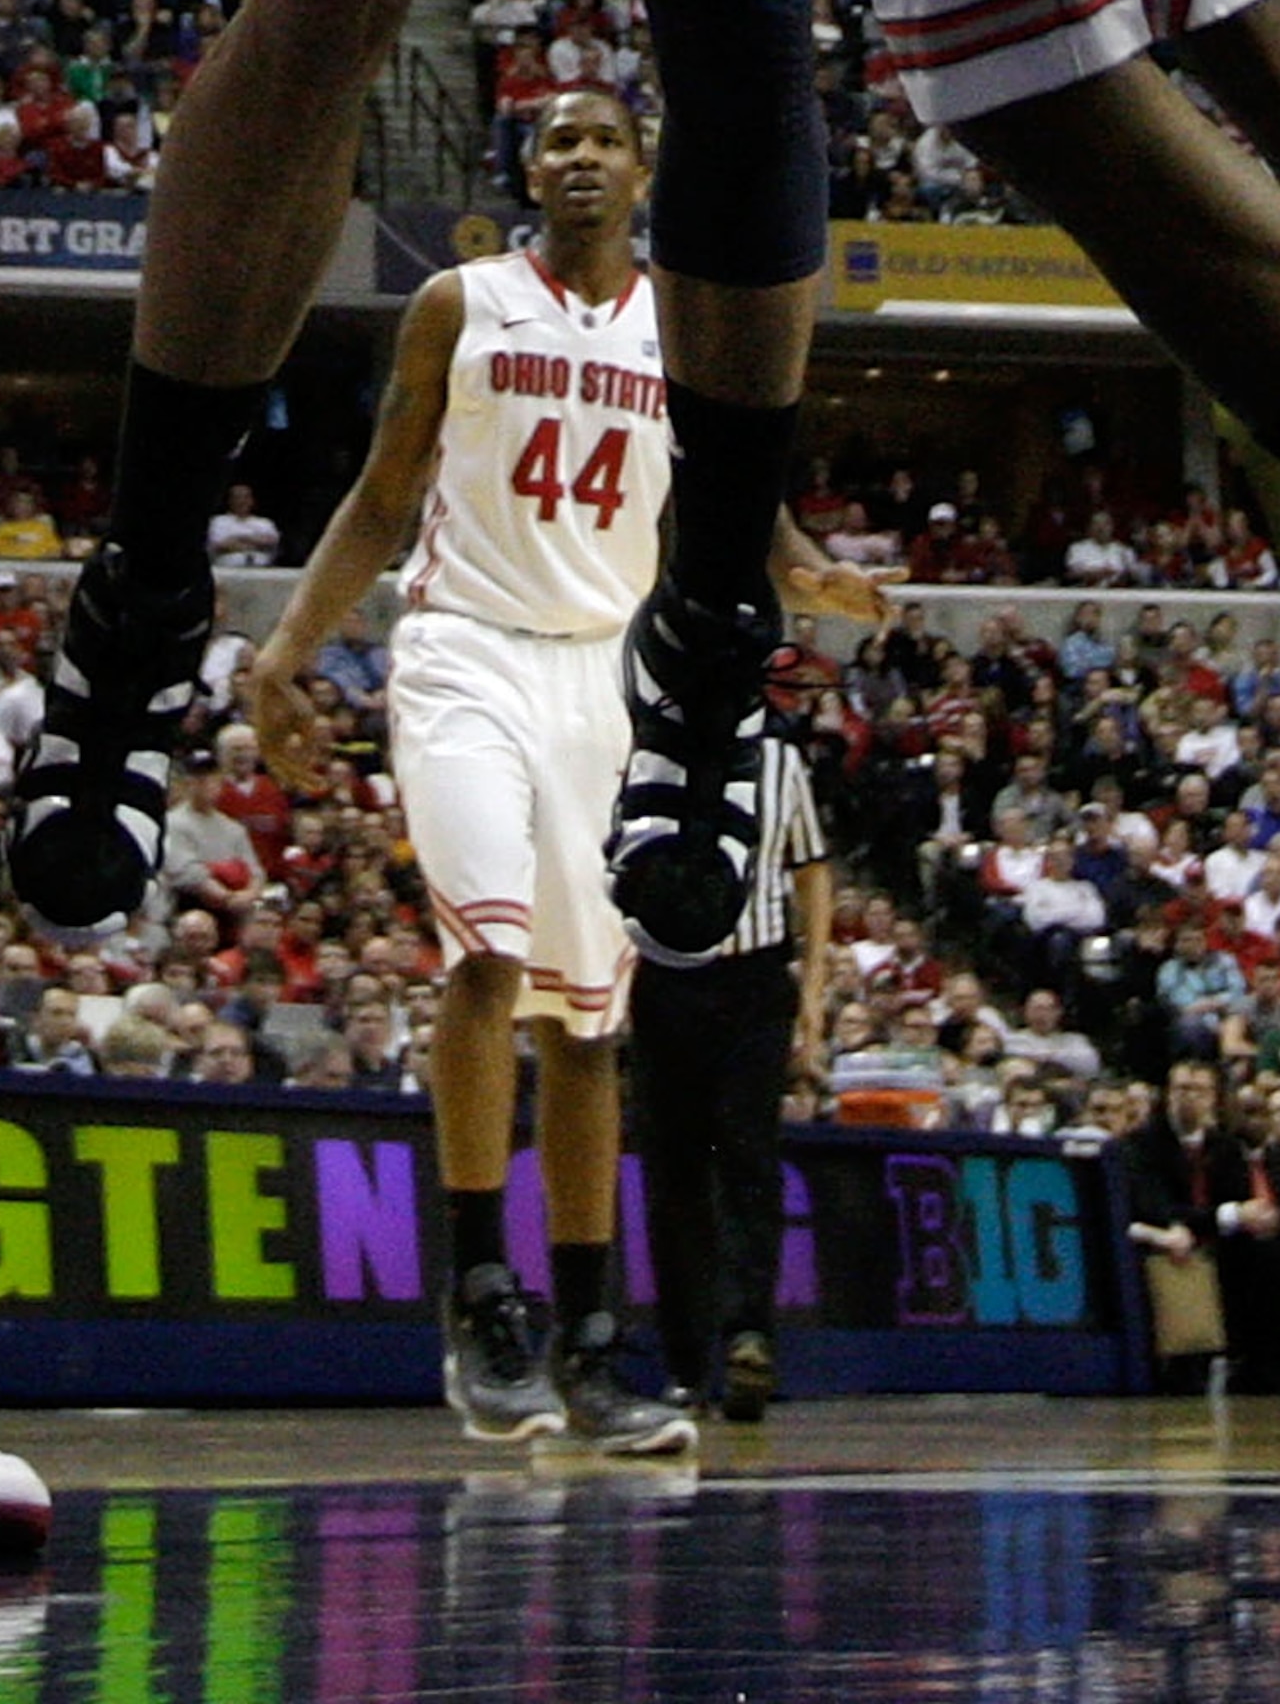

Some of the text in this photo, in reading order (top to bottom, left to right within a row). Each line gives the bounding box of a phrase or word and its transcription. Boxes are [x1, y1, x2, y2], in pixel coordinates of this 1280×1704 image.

[490, 352, 670, 420] OHIO STATE
[513, 418, 630, 529] 44
